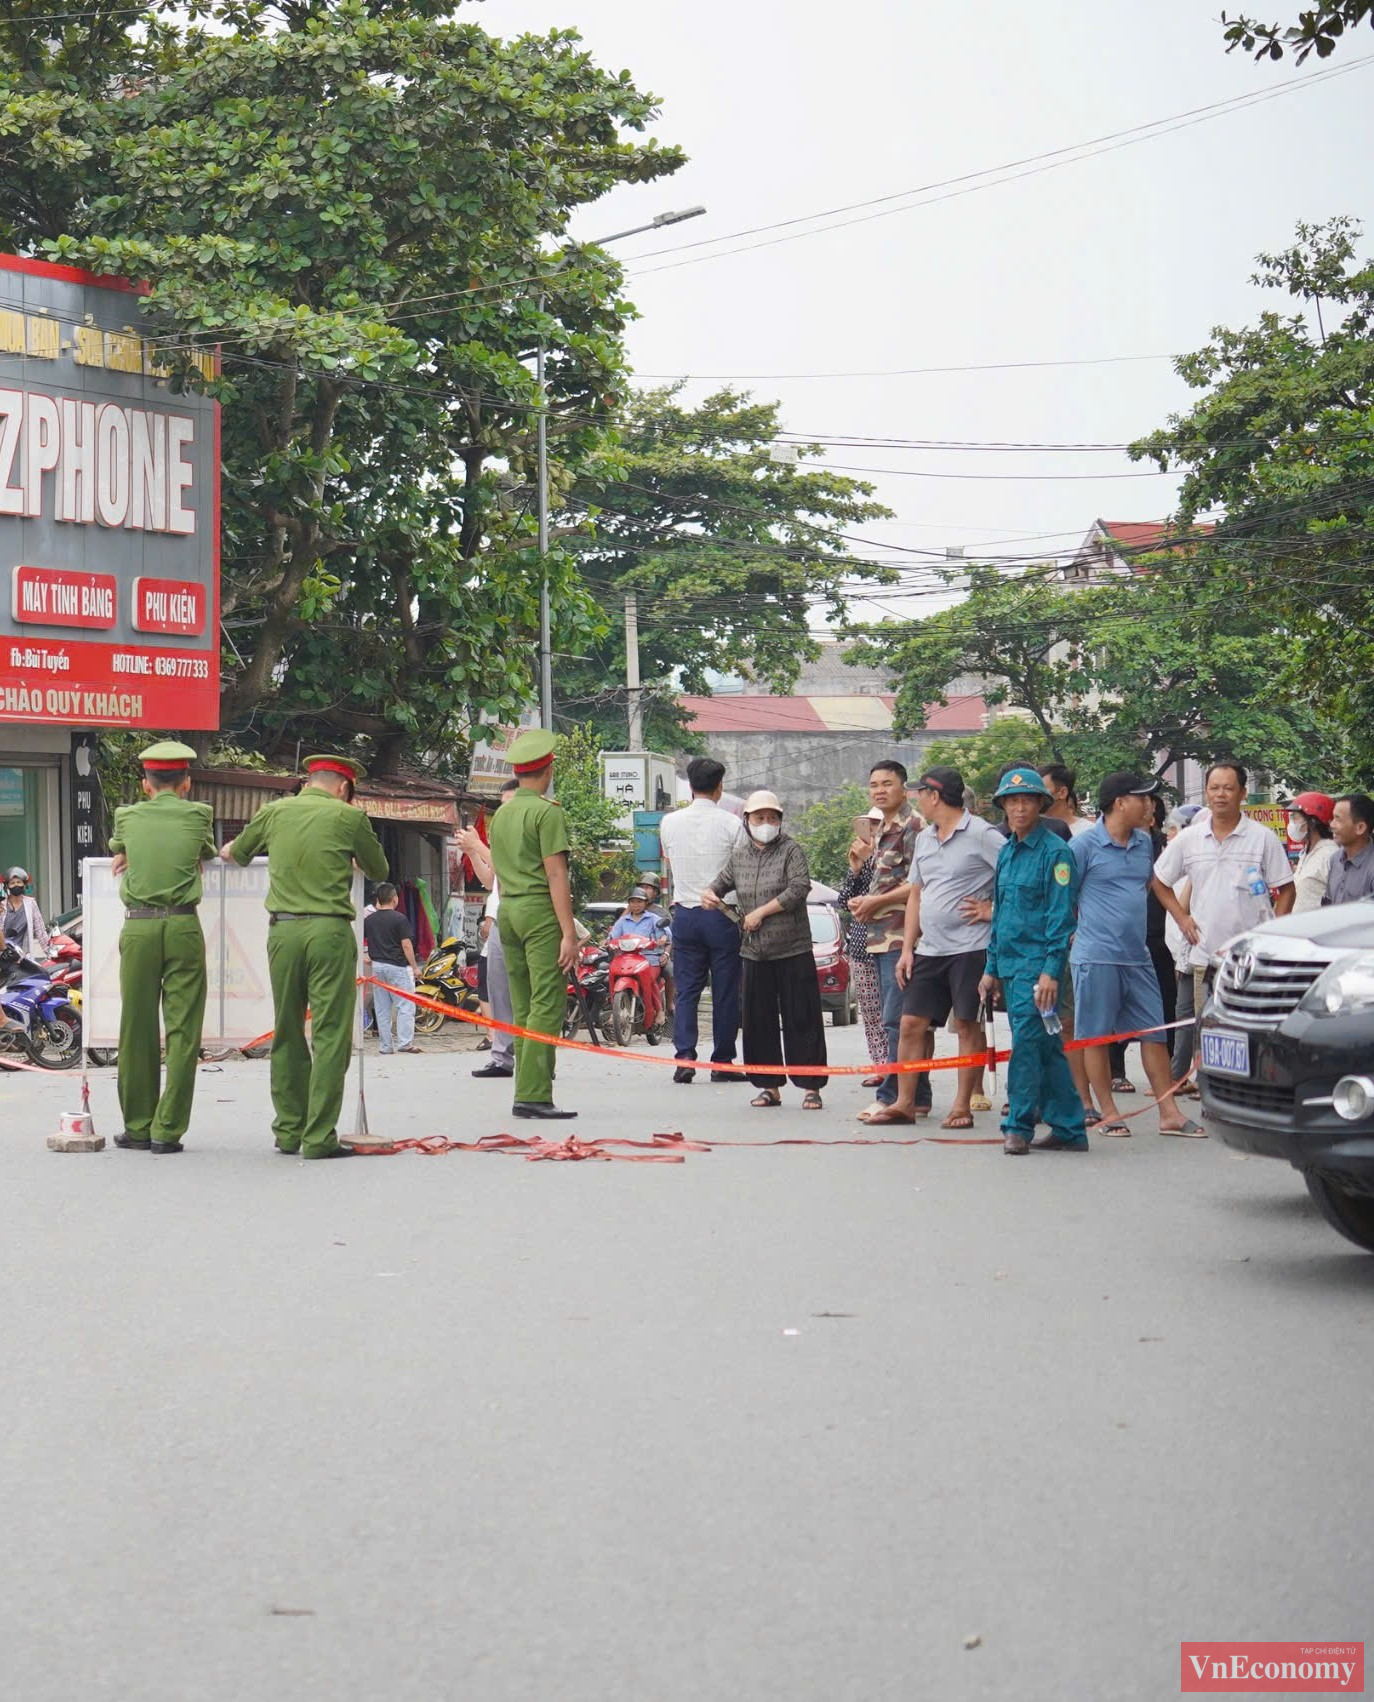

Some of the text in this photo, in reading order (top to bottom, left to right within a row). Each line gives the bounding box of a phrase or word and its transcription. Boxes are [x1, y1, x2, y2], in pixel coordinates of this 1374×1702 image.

[23, 575, 113, 618] MÁY TÍNH BẢNG
[146, 589, 196, 630] PHỤ KIỆN
[112, 653, 152, 675] HOTLINE:
[46, 683, 81, 715] QUÝ
[84, 686, 143, 717] KHÁCH
[77, 791, 91, 813] PHỤ
[77, 822, 93, 847] KIỆN
